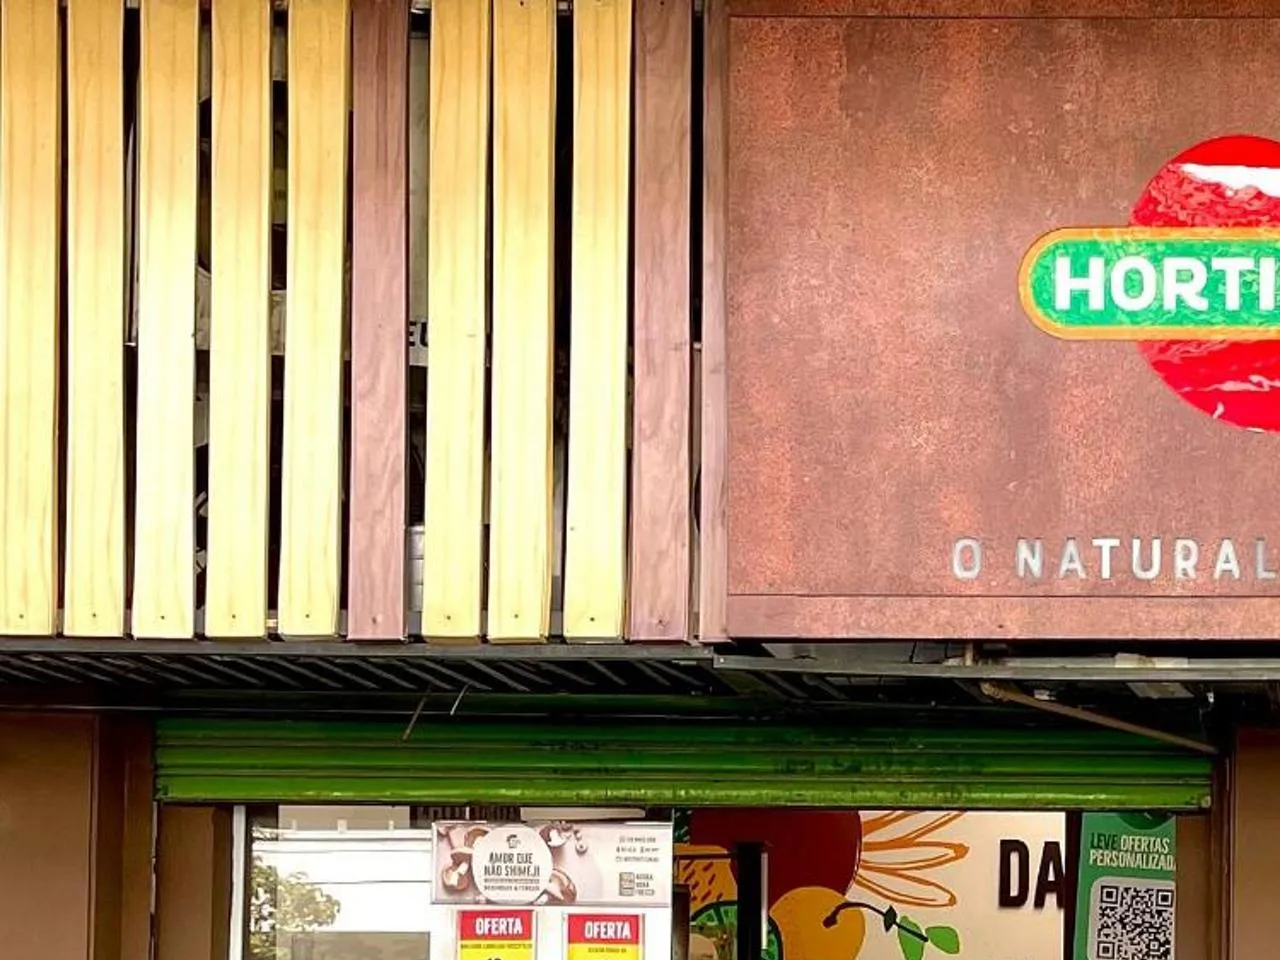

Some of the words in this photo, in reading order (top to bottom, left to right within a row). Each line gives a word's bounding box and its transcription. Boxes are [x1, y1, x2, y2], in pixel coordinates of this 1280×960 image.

[951, 537, 984, 581] O
[1016, 537, 1279, 581] NATURAL
[1090, 832, 1118, 850] LEVE
[1120, 834, 1170, 854] OFERTAS
[998, 839, 1065, 910] DA
[475, 917, 523, 936] OFERTA
[584, 920, 632, 939] OFERTA
